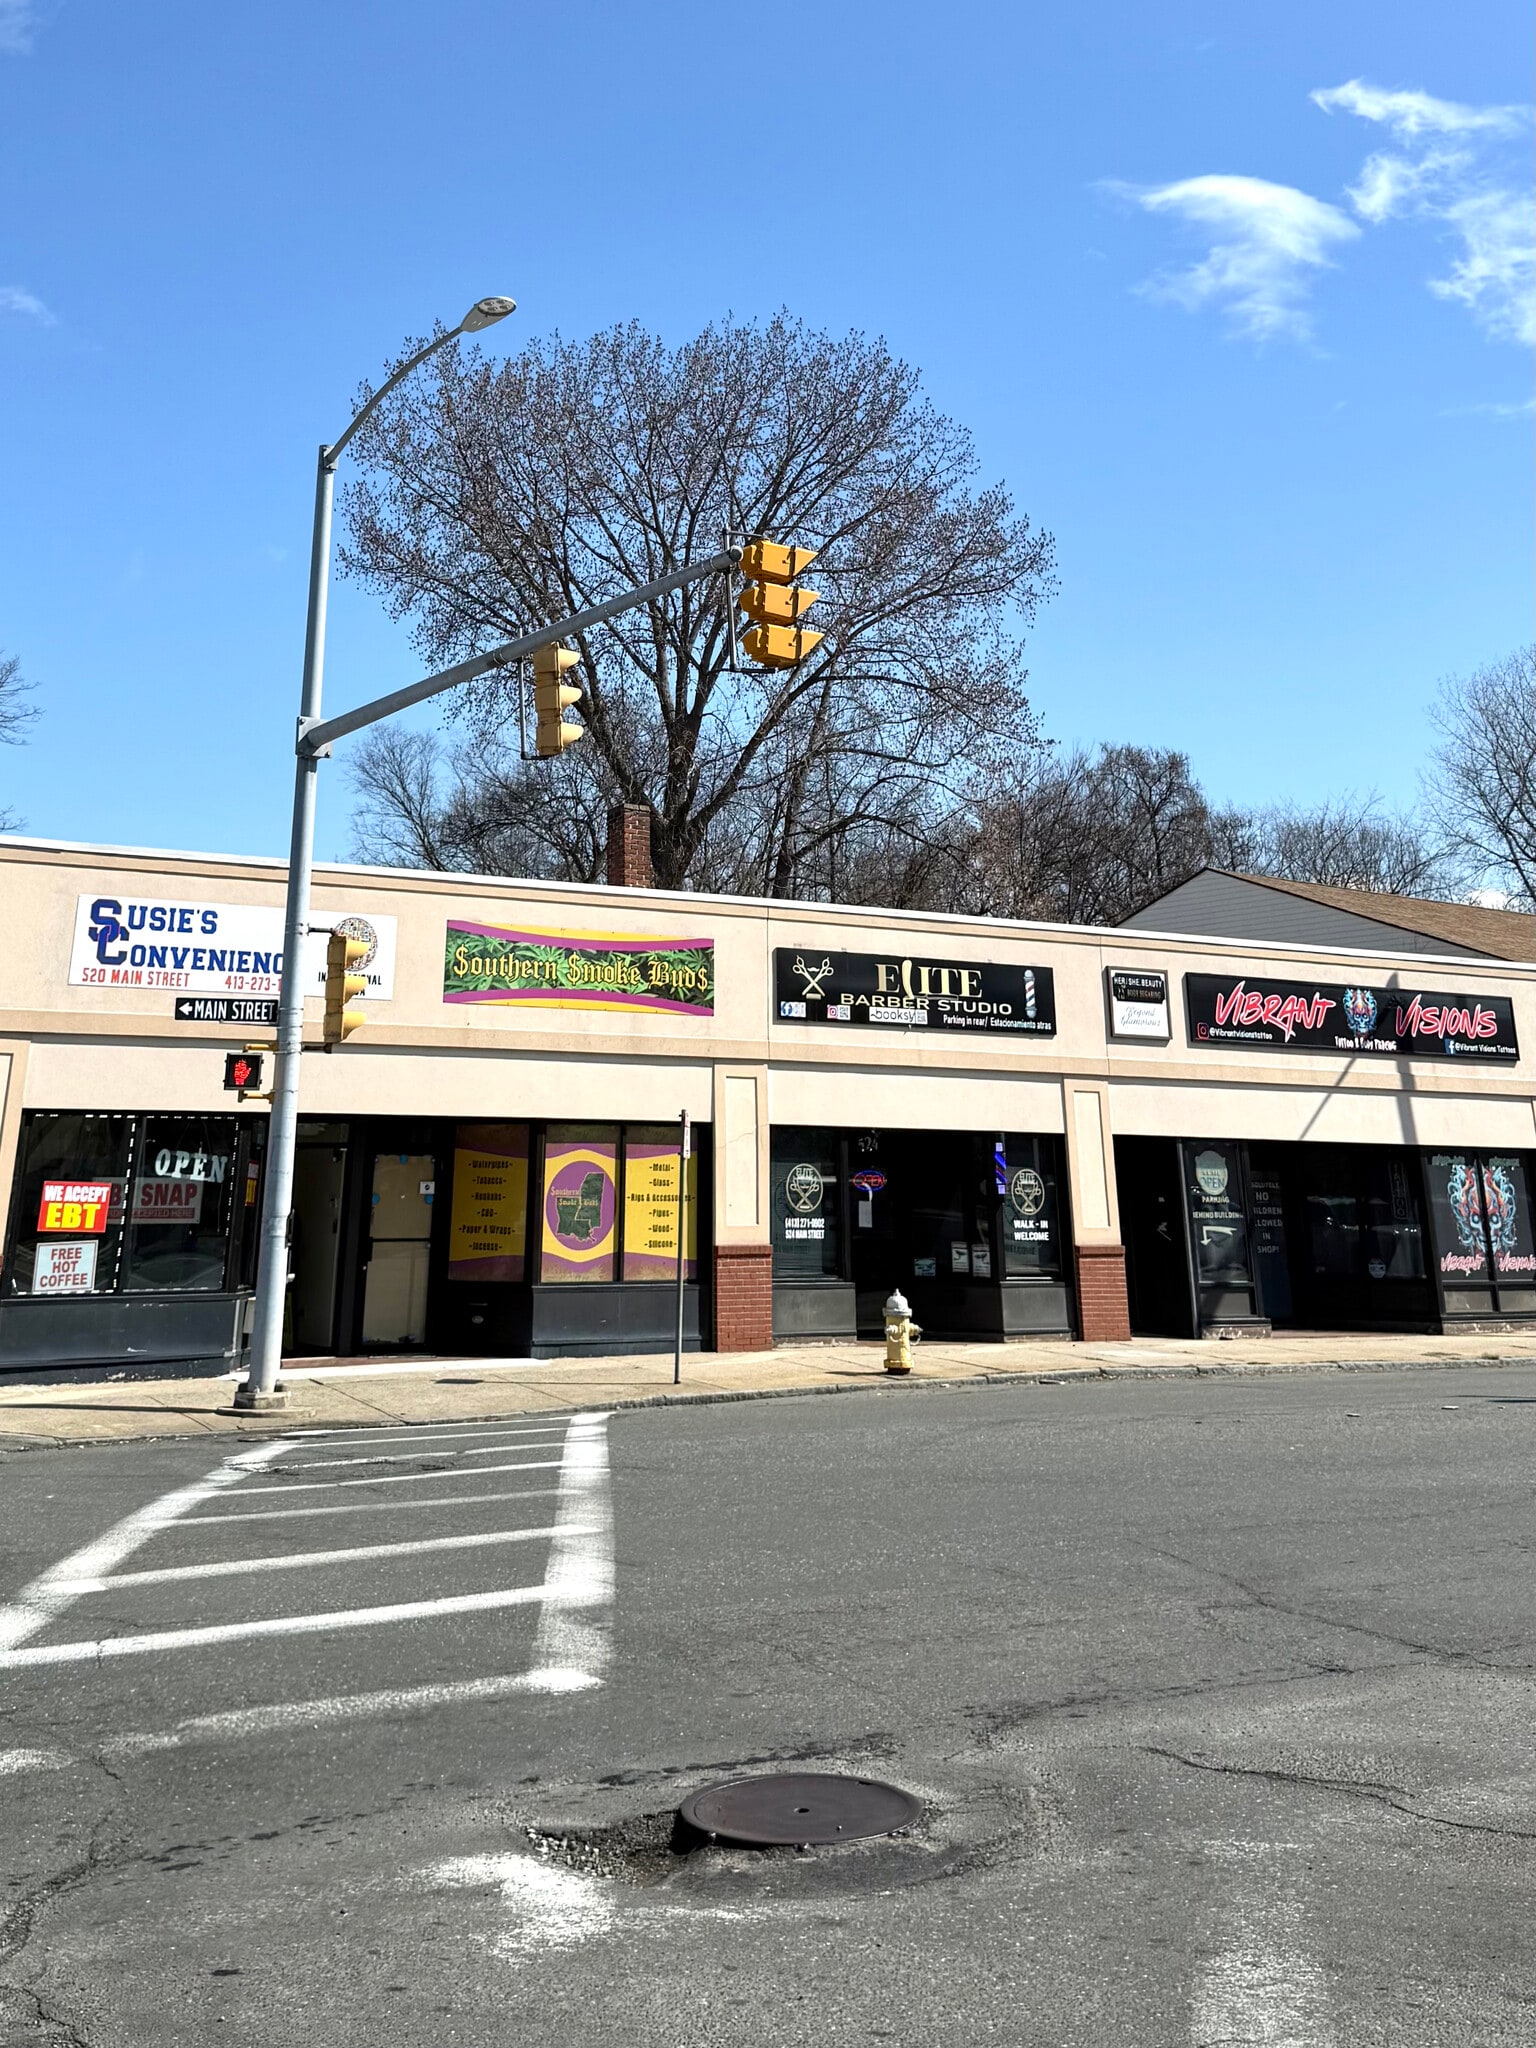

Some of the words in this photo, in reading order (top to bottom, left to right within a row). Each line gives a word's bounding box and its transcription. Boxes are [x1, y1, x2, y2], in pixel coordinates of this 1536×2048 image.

[88, 899, 218, 942] SUSIE'S
[96, 925, 284, 974] CONVENIENC
[82, 968, 106, 983] 520
[111, 969, 142, 985] MAIN
[147, 971, 190, 987] STREET
[194, 1000, 226, 1019] MAIN
[232, 1001, 275, 1021] STREET
[840, 993, 930, 1010] BARBER
[937, 1000, 1012, 1015] STUDIO
[871, 1009, 916, 1023] booksy
[1215, 980, 1336, 1043] VIBRANT
[1396, 993, 1498, 1039] VISIONS
[943, 1015, 966, 1026] Parking
[966, 1016, 972, 1025] in
[990, 1017, 1036, 1029] Estacionamiento
[155, 1148, 228, 1183] OPEN
[1199, 1177, 1225, 1189] OPEN
[44, 1185, 63, 1202] WE
[64, 1186, 110, 1203] ACCEPT
[141, 1183, 198, 1206] SNAP
[1201, 1196, 1230, 1204] PARKING
[1255, 1191, 1269, 1201] NO
[45, 1202, 101, 1229] EBT
[1013, 1219, 1034, 1229] WALK
[1040, 1220, 1049, 1229] IN
[796, 1230, 807, 1239] MAIN
[808, 1230, 825, 1239] STREET
[1014, 1231, 1050, 1241] WELCOME
[1262, 1232, 1271, 1240] IN
[51, 1247, 82, 1260] FREE
[52, 1261, 78, 1273] HOT
[40, 1273, 88, 1287] COFFEE
